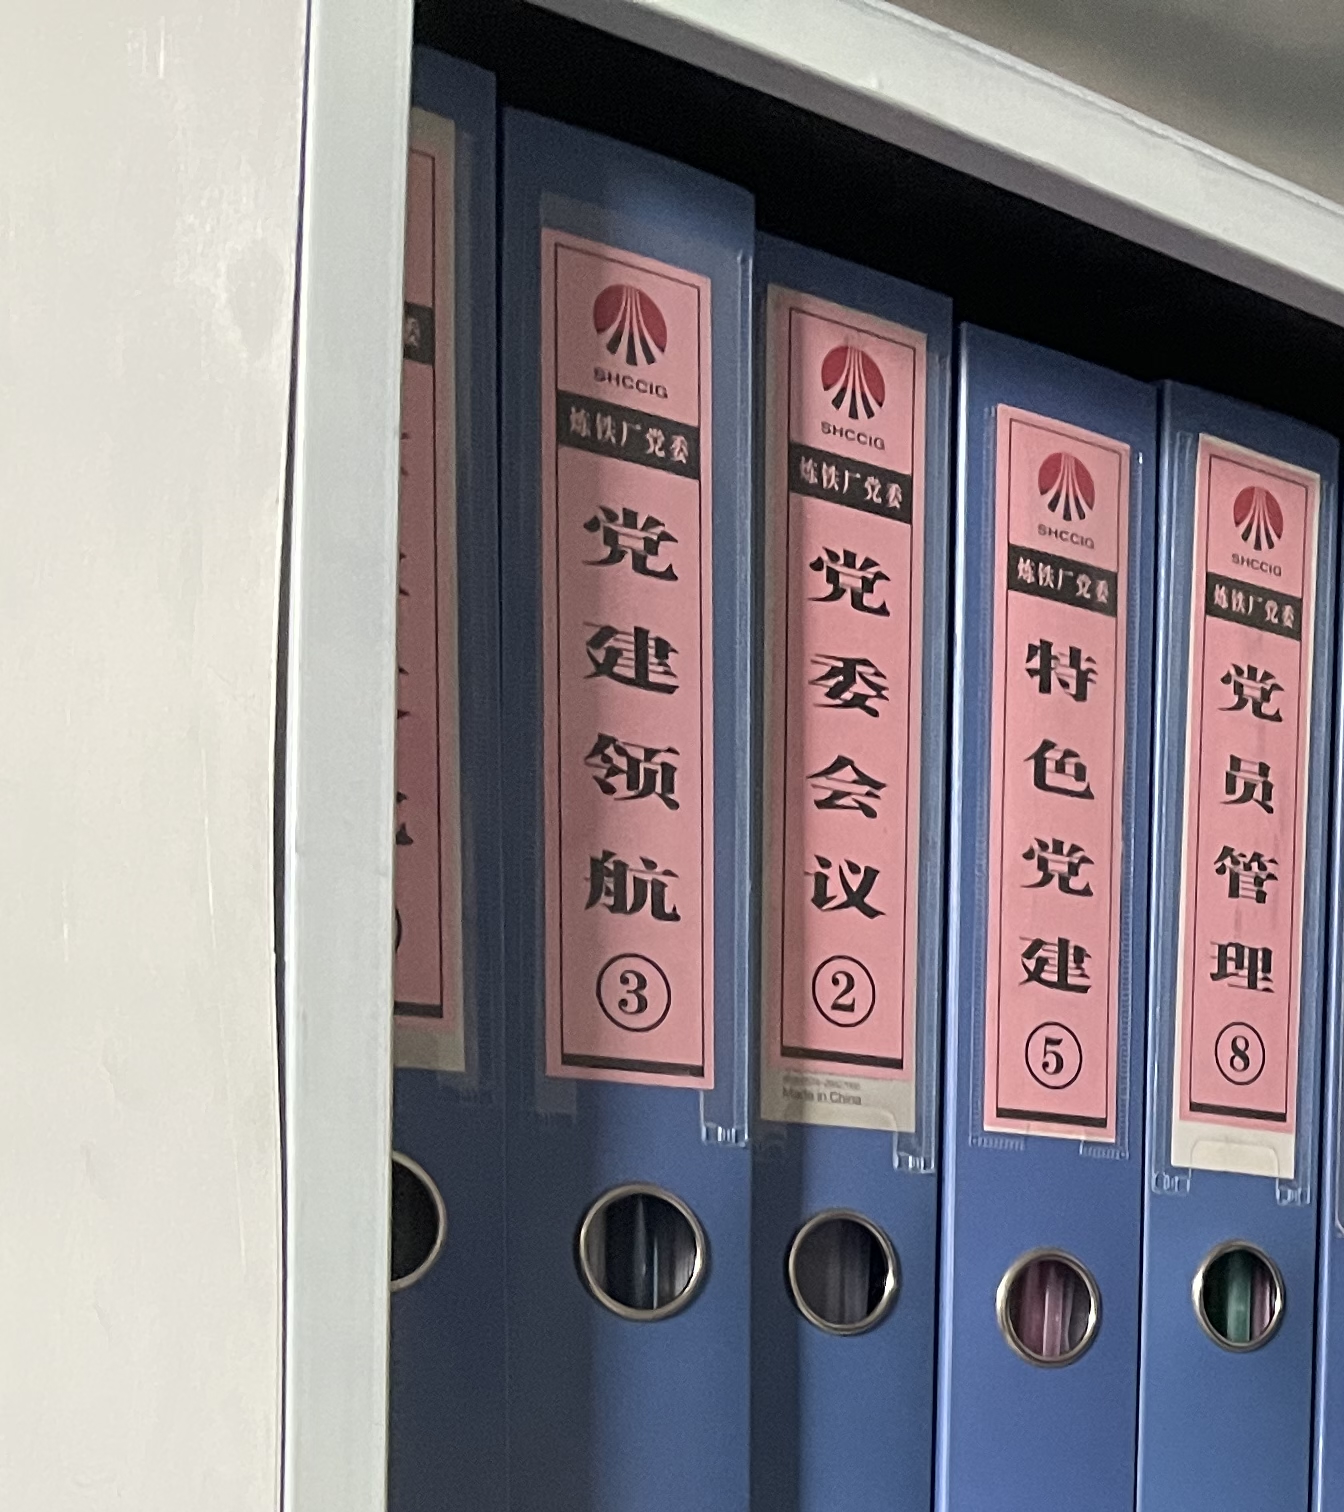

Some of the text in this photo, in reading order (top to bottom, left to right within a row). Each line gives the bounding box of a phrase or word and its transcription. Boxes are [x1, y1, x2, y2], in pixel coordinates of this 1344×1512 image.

[594, 367, 669, 399] SHCCIG
[569, 405, 690, 464] 炼铁厂党委
[821, 420, 885, 450] SHCCIG
[800, 455, 902, 508] 炼铁厂党委
[1037, 524, 1095, 549] SHCCIG
[1016, 555, 1110, 604] 炼铁厂党委
[1232, 553, 1282, 577] SHCCIG
[582, 505, 681, 922] 党建领航
[806, 547, 891, 919] 党委会议
[1019, 637, 1099, 994] 特色党建
[1209, 662, 1285, 994] 党员管理
[830, 1092, 861, 1105] China
